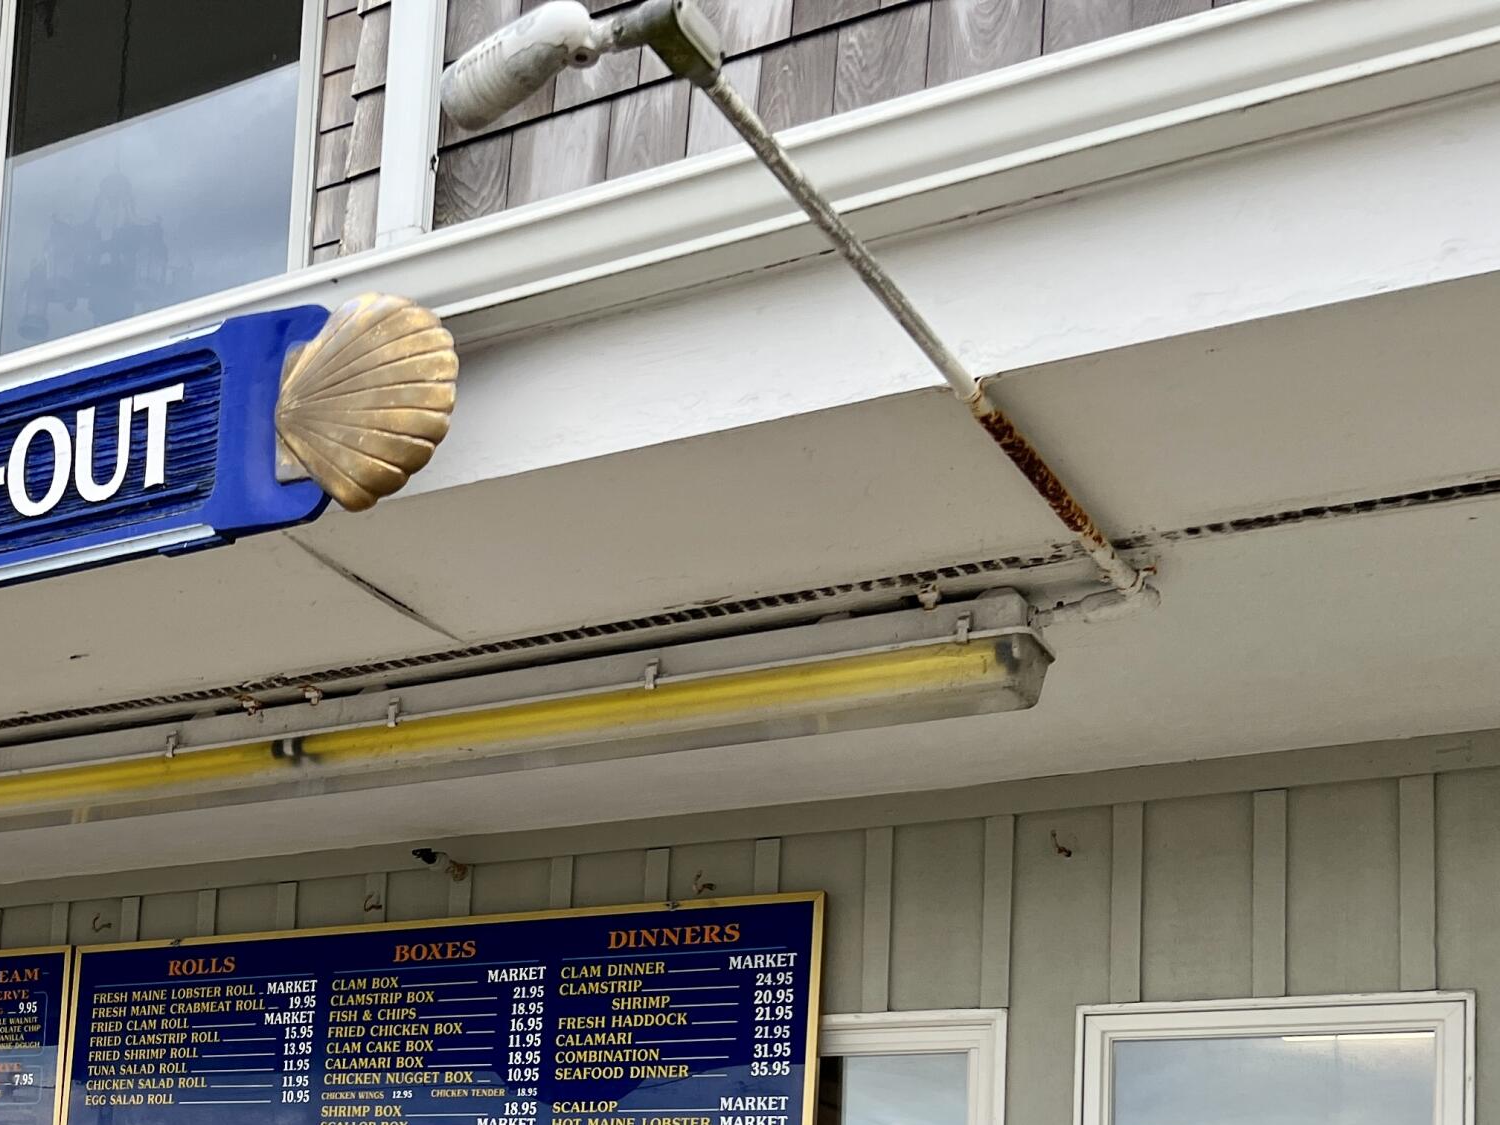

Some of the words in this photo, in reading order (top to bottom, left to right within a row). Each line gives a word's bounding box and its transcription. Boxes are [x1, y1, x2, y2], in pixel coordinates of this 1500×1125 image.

[607, 924, 740, 949] DINNERS
[393, 941, 476, 962] BOXES
[169, 956, 236, 976] ROLLS
[561, 966, 601, 979] CLAM
[607, 962, 665, 976] DINNER
[728, 953, 797, 970] MARKET
[332, 978, 367, 991] CLAM
[372, 977, 398, 989] BOX
[487, 967, 546, 983] MARKET
[559, 980, 643, 995] CLAMSTRIP
[756, 972, 793, 986] 24.95
[93, 993, 128, 1003] FRESH
[132, 990, 167, 1001] MAINE
[172, 987, 221, 1000] LOBSTER
[226, 985, 255, 996] ROLL
[267, 980, 317, 994] MARKET
[612, 996, 670, 1010] SHRIMP
[754, 989, 794, 1004] 20.95
[18, 1002, 37, 1013] 9.95
[92, 1008, 126, 1018] FRESH
[131, 1005, 165, 1016] MAINE
[170, 1001, 232, 1014] CRABMEAT
[236, 999, 266, 1011] ROLL
[289, 995, 316, 1009] 19.95
[329, 1011, 357, 1022] FISH
[363, 1011, 372, 1020] &
[378, 1009, 416, 1020] CHIPS
[512, 1002, 543, 1015] 18.95
[328, 1027, 365, 1038] FRIED
[370, 1024, 429, 1037] CHICKEN
[434, 1023, 463, 1034] BOX
[510, 1018, 543, 1031] 16.95
[558, 1017, 605, 1029] FRESH
[611, 1013, 687, 1028] HADDOCK
[755, 1006, 793, 1021] 21.95
[555, 1049, 660, 1063] COMBINATION
[753, 1042, 791, 1058] 31.95
[555, 1067, 623, 1080] SEAFOOD
[630, 1065, 689, 1079] DINNER
[751, 1061, 790, 1076] 35.95
[86, 1080, 134, 1091] CHICKEN
[138, 1078, 174, 1089] SALAD
[179, 1077, 207, 1088] ROLL
[282, 1075, 309, 1087] 11.95
[85, 1095, 106, 1105] EGG
[110, 1095, 143, 1105] SALAD
[147, 1094, 174, 1104] ROLL
[281, 1090, 310, 1103] 10.95
[321, 1092, 355, 1100] CHICKEN
[358, 1091, 384, 1099] WINGS
[431, 1089, 468, 1097] CHICKEN
[517, 1088, 537, 1096] 18.95
